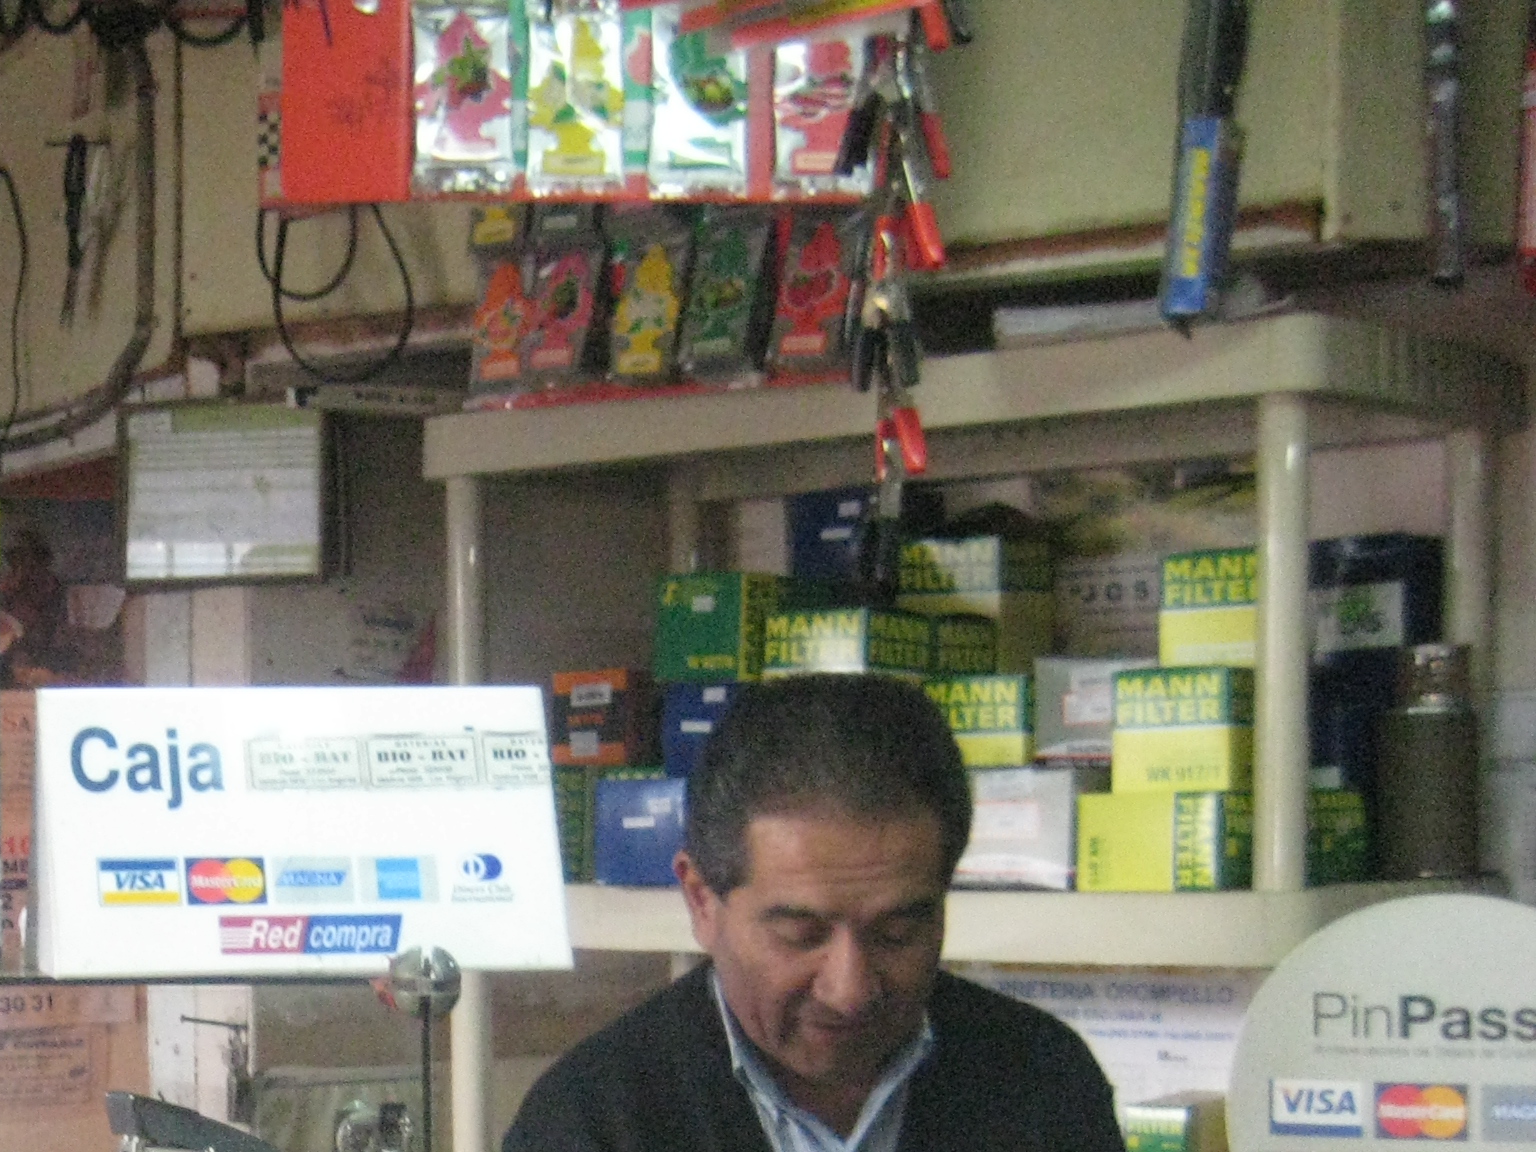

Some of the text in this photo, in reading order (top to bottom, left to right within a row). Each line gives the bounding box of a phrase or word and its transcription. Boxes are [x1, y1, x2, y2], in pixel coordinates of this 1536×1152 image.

[765, 613, 862, 639] MANN
[1117, 673, 1221, 697] MANN
[1116, 698, 1220, 724] FILTER
[69, 727, 224, 810] Caja
[115, 872, 166, 891] VISA
[249, 919, 392, 954] Red compra
[1312, 991, 1536, 1042] PinPass
[1280, 1087, 1358, 1115] VISA
